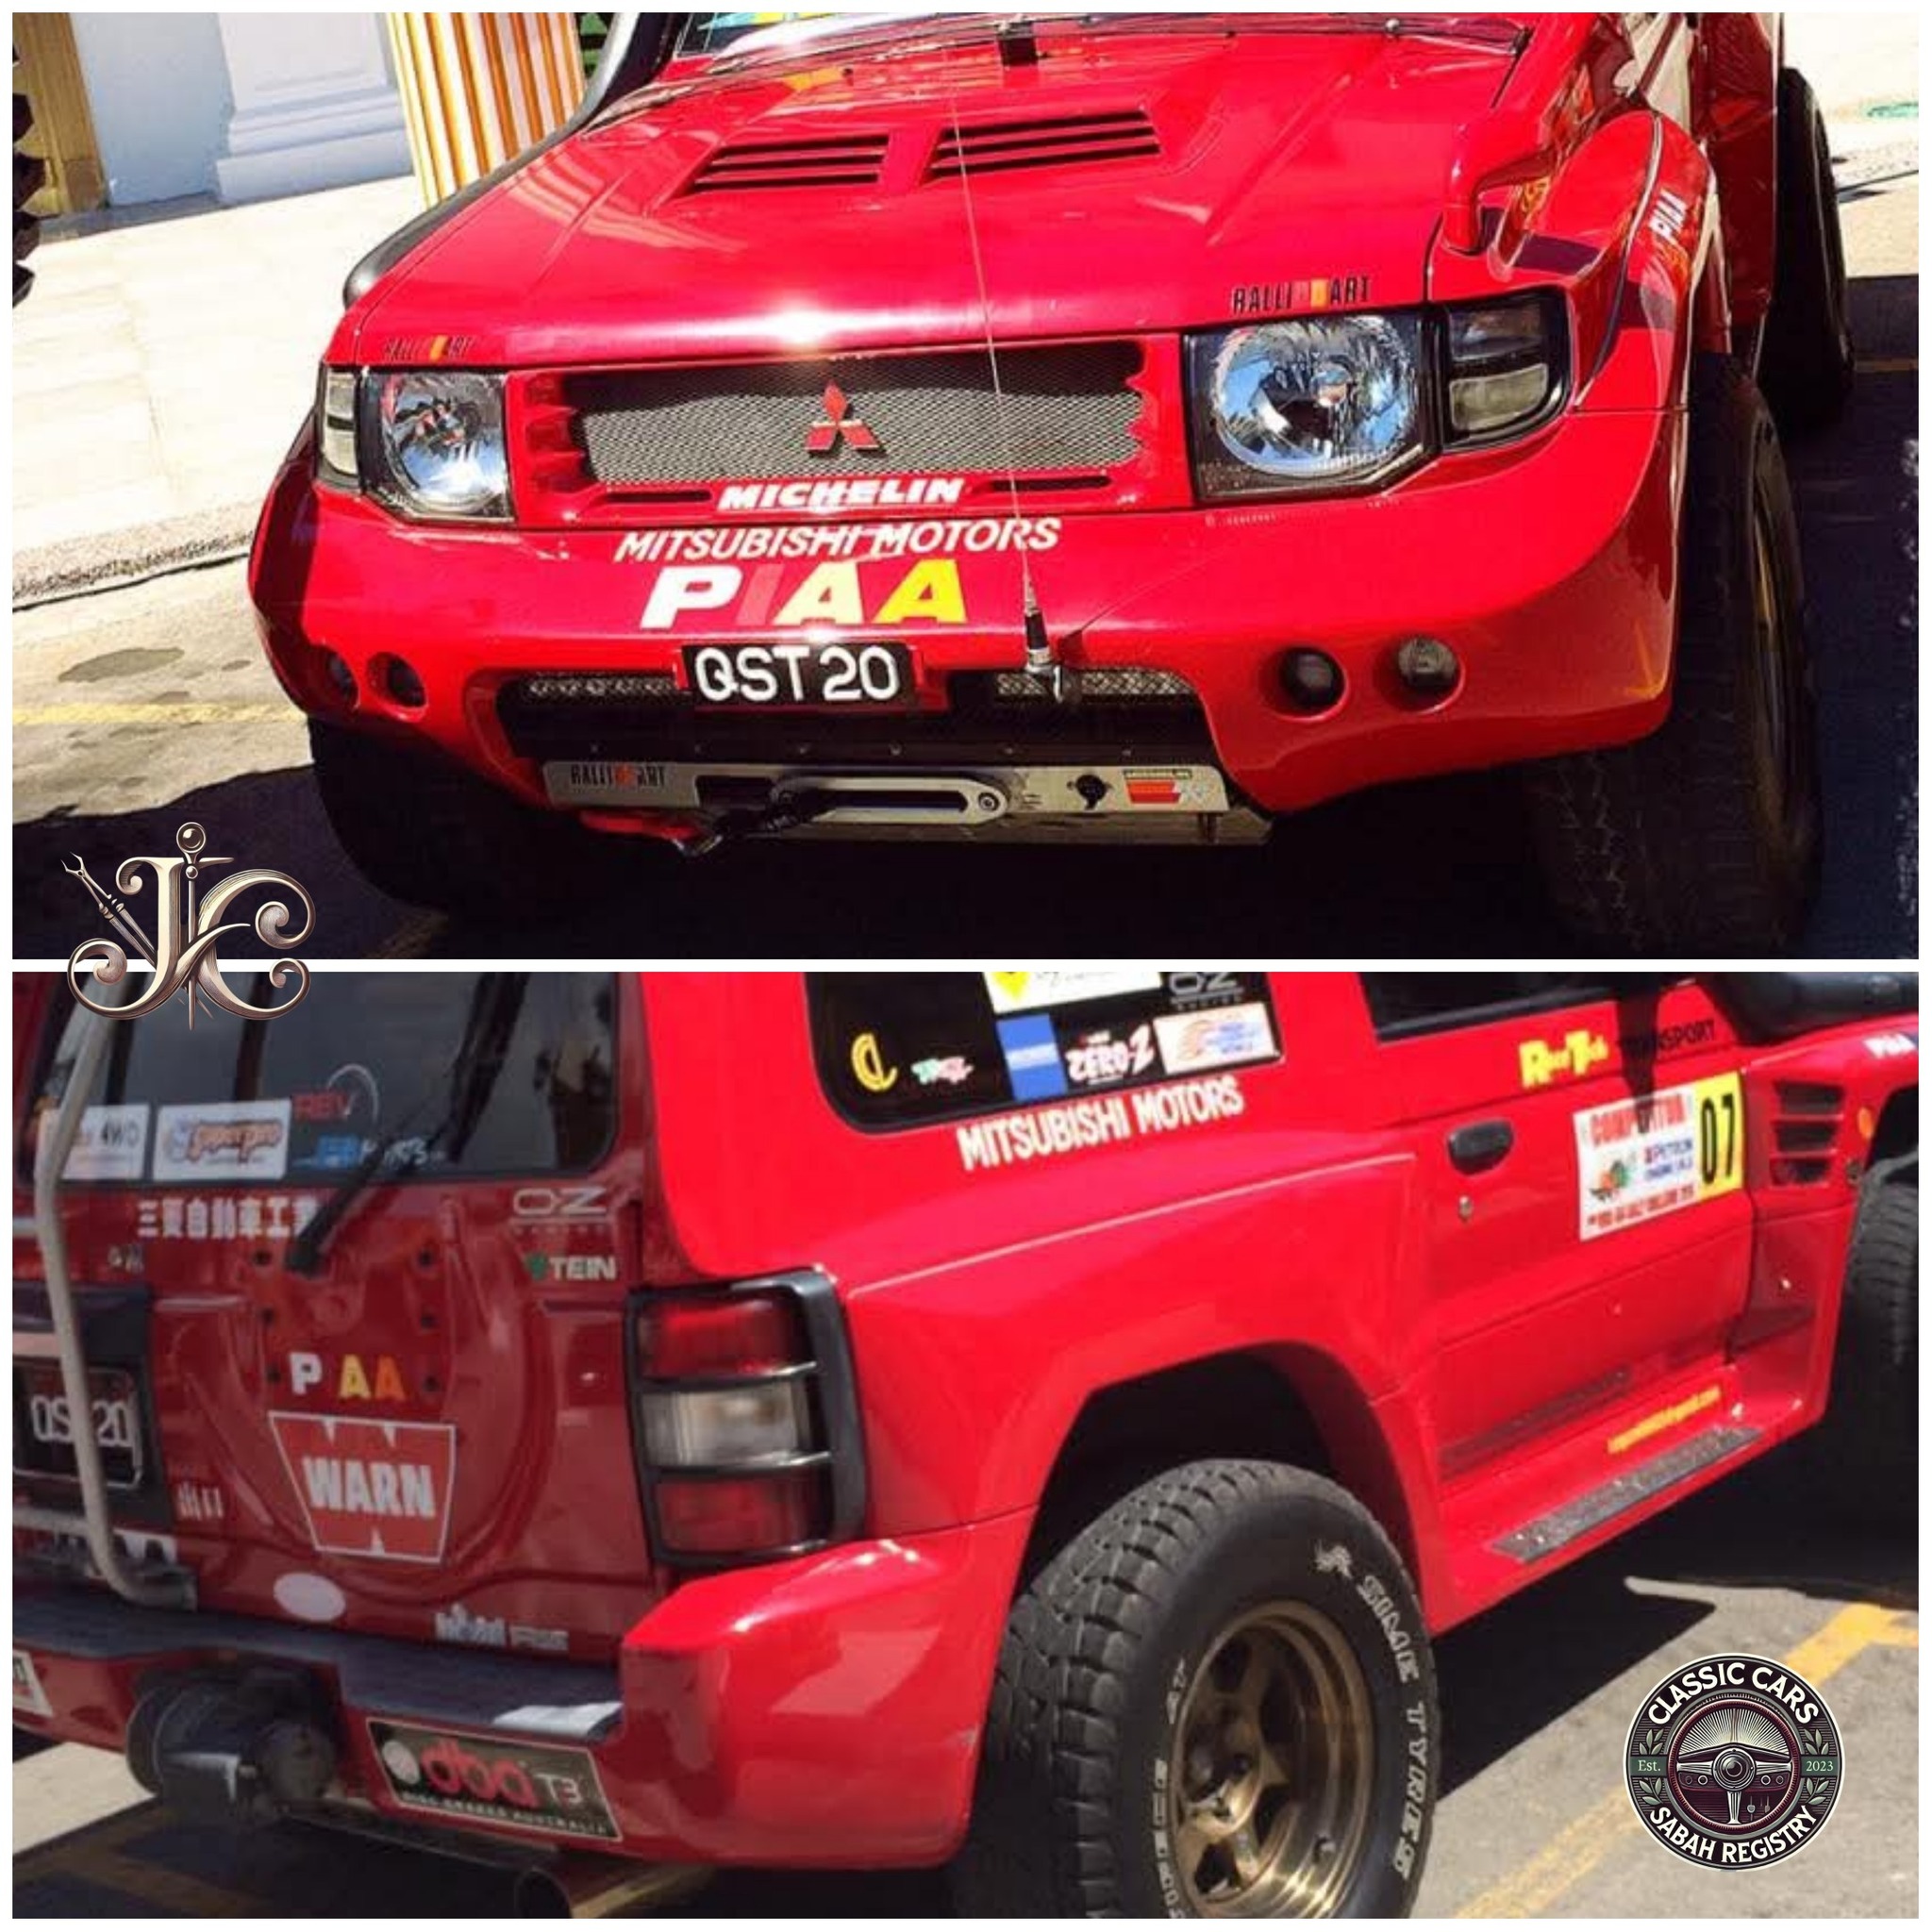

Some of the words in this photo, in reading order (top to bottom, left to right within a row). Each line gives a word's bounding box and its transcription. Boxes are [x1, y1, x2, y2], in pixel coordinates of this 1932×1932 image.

[718, 477, 963, 510] MICHELIN
[614, 524, 863, 563] MITSUBISHI
[874, 517, 1062, 558] MOTORS
[640, 558, 968, 629] PIAA
[693, 644, 811, 701] QST
[819, 645, 902, 701] 20
[956, 1096, 1131, 1171] MITSUBISHI
[1132, 1074, 1245, 1135] MOTORS
[1701, 1092, 1736, 1185] 07
[549, 1256, 616, 1280] TEIN
[290, 1352, 407, 1400] PAA
[303, 1457, 435, 1518] WARN
[1357, 1574, 1420, 1684] SIME
[421, 1738, 540, 1808] dba
[1392, 1701, 1428, 1881] TYRES
